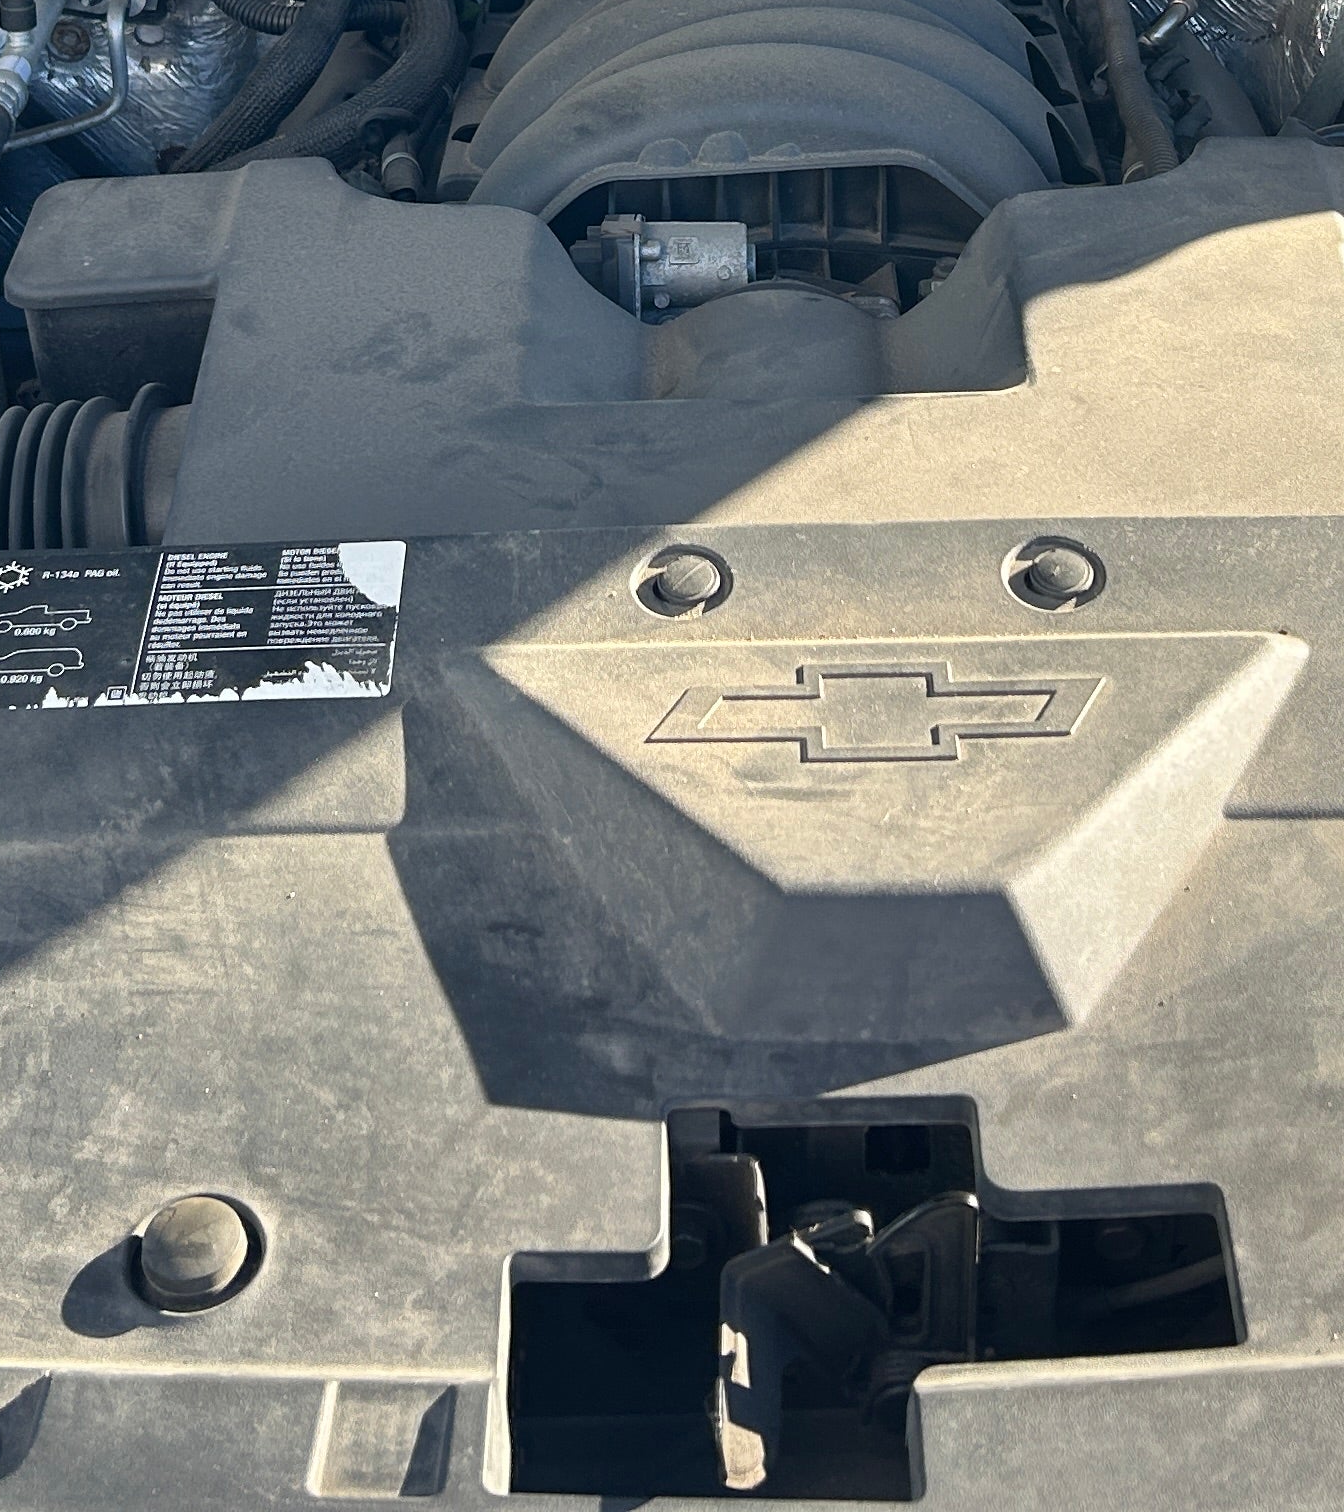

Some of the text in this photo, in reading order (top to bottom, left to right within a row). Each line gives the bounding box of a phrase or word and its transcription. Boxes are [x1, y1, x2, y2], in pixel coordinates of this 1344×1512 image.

[167, 553, 196, 561] DIESEL
[84, 569, 105, 578] PAG
[158, 594, 193, 602] MOTEUR
[43, 627, 56, 637] kg
[29, 674, 44, 684] kg
